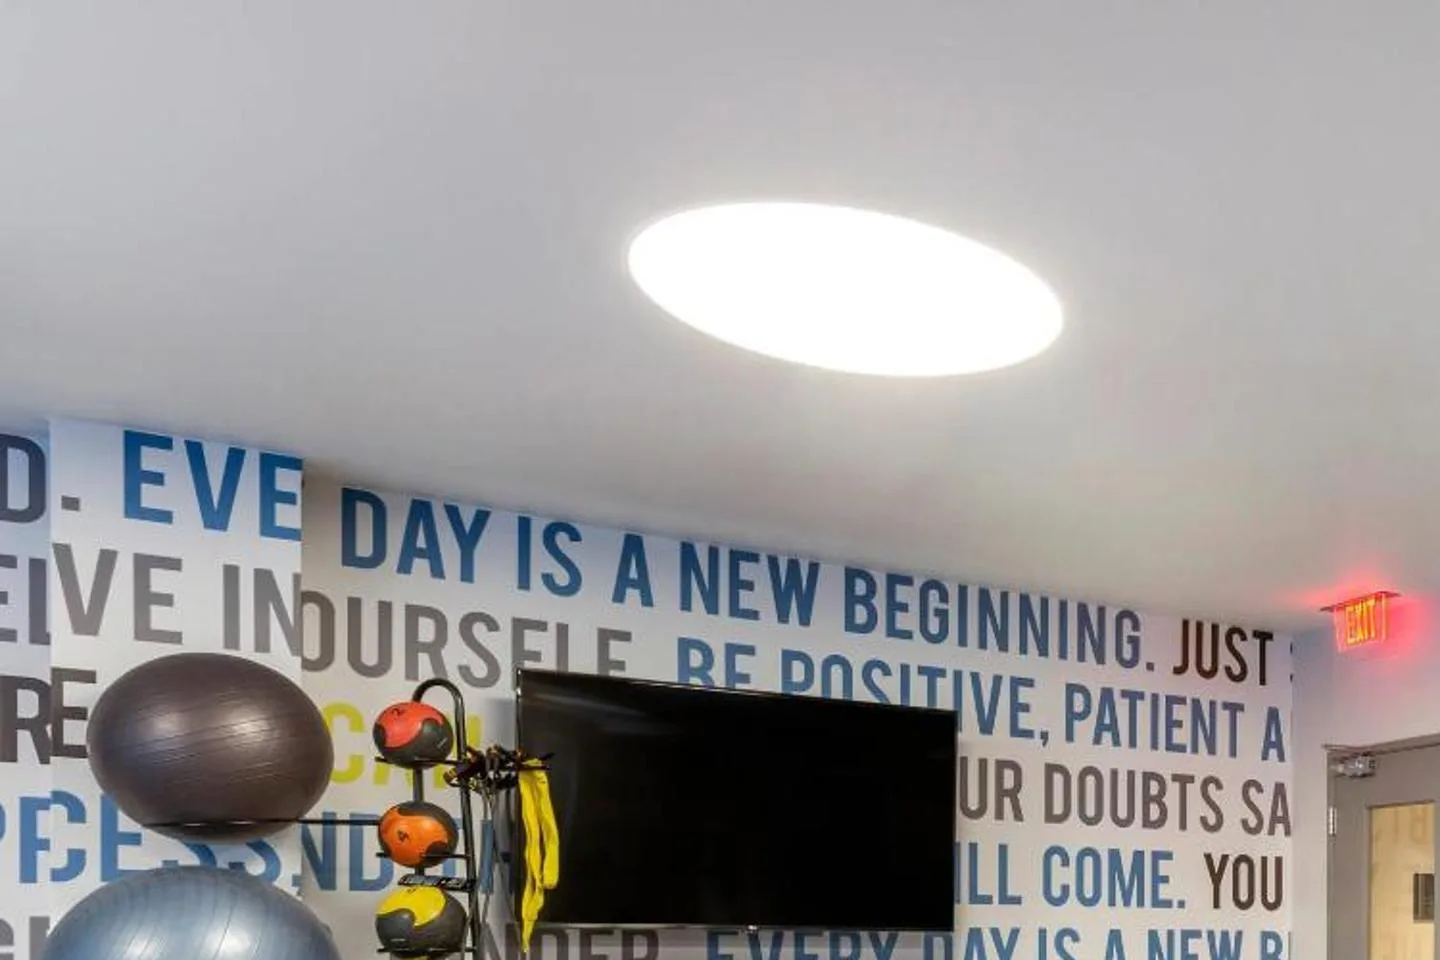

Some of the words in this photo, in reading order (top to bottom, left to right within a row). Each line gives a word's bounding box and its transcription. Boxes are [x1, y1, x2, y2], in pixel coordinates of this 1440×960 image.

[341, 487, 491, 583] DAY
[517, 515, 582, 597] IS
[612, 533, 653, 607] A
[679, 541, 820, 626] NEW
[844, 566, 1155, 671] BEGINNING.
[1173, 618, 1274, 686] JUST
[1345, 599, 1377, 646] EXIT
[1064, 682, 1245, 758] PATIENT
[1043, 762, 1224, 834] DOUBTS
[1042, 844, 1186, 909] COME.
[1203, 852, 1283, 911] YOU
